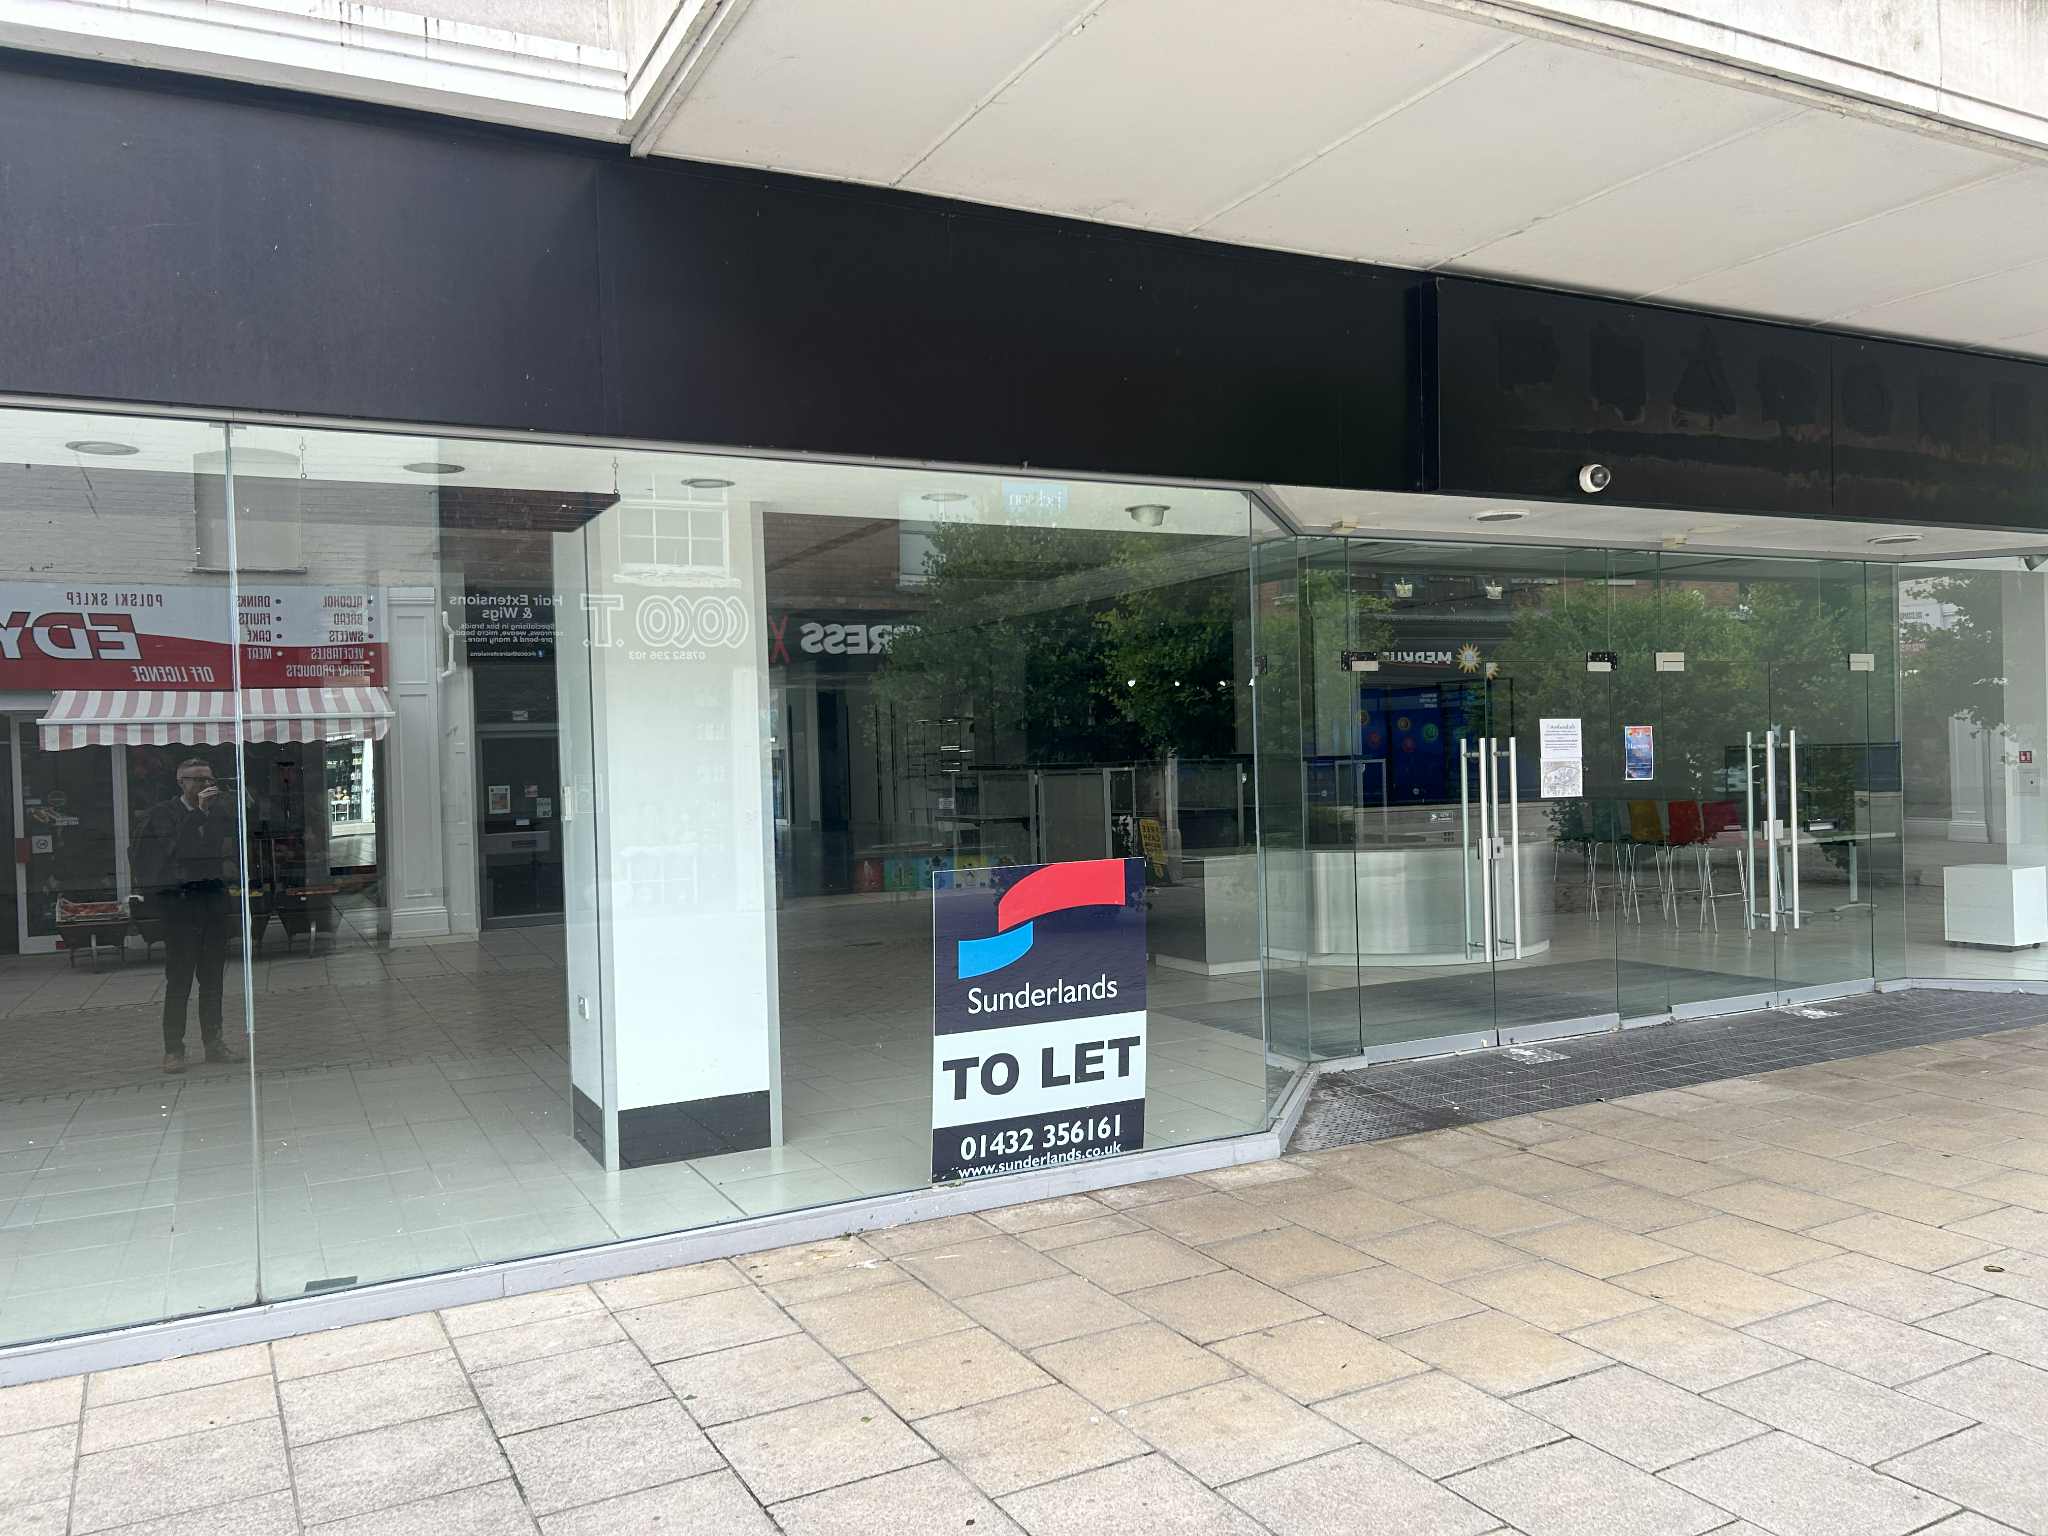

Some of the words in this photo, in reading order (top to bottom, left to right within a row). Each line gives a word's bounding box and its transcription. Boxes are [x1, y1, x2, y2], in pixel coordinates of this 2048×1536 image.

[967, 973, 1119, 1015] Sunderlands
[942, 1052, 1020, 1101] TO
[1041, 1035, 1141, 1089] LET
[960, 1127, 1034, 1161] 01432
[1042, 1114, 1121, 1148] 356161
[957, 1141, 1122, 1179] www.sunderlands.co.uk
